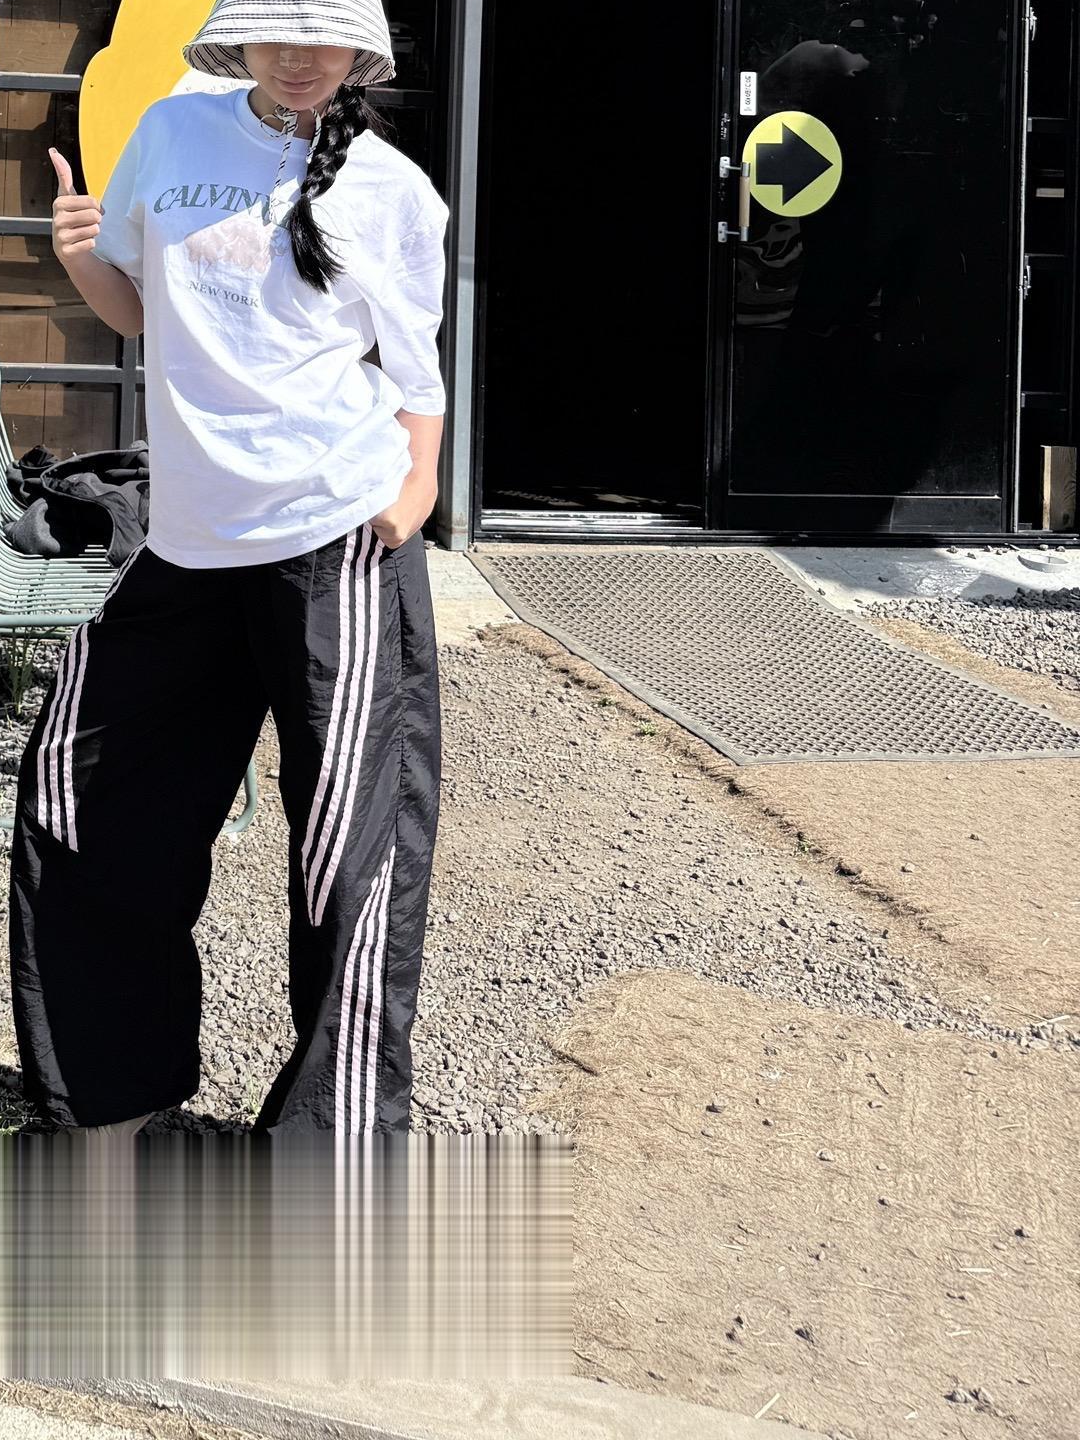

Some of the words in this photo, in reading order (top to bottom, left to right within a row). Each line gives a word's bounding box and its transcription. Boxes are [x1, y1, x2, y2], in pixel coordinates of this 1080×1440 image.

[153, 183, 261, 216] CALVIN
[189, 280, 220, 297] NEW
[223, 289, 259, 308] YORK
